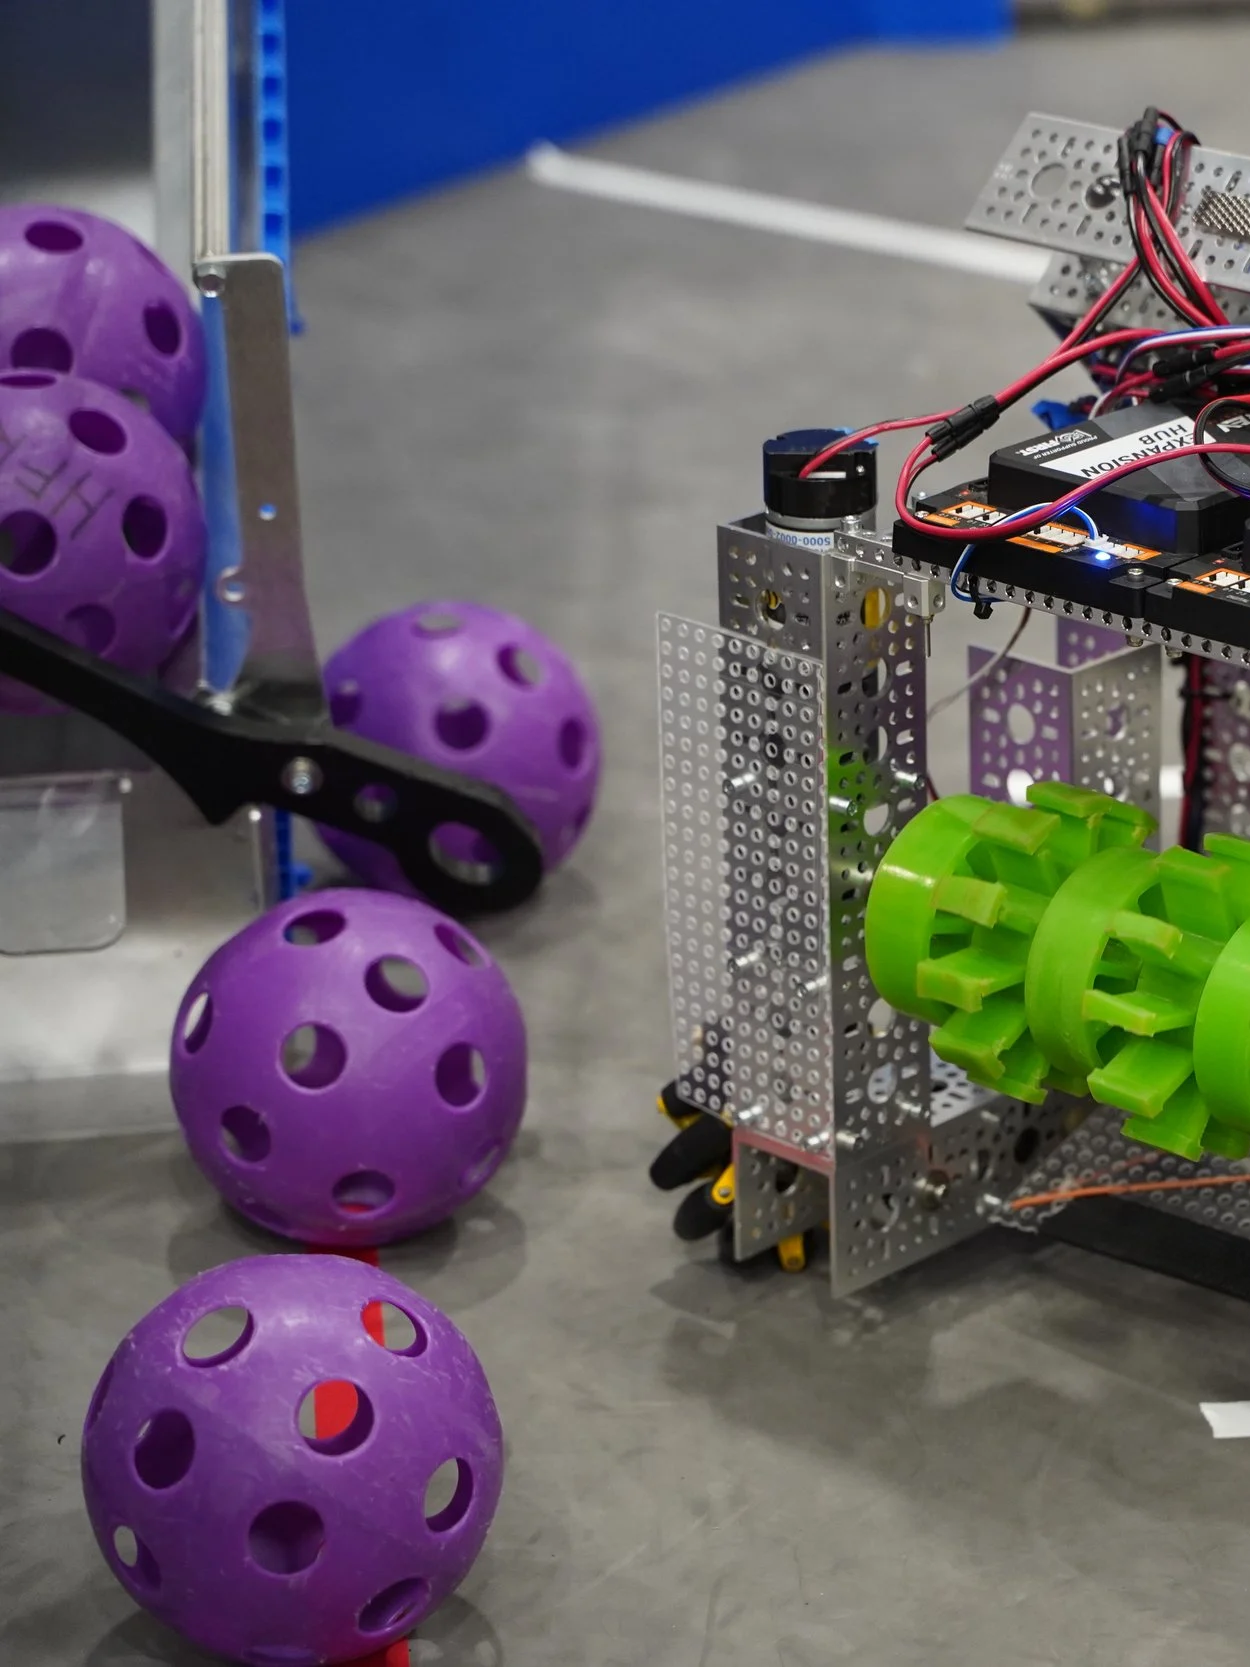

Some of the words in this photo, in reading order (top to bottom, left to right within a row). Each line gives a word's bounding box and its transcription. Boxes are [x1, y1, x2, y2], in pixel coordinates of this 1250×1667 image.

[1077, 435, 1098, 446] PROUD
[1138, 424, 1187, 445] HUB
[1042, 441, 1077, 457] SUPPORTER
